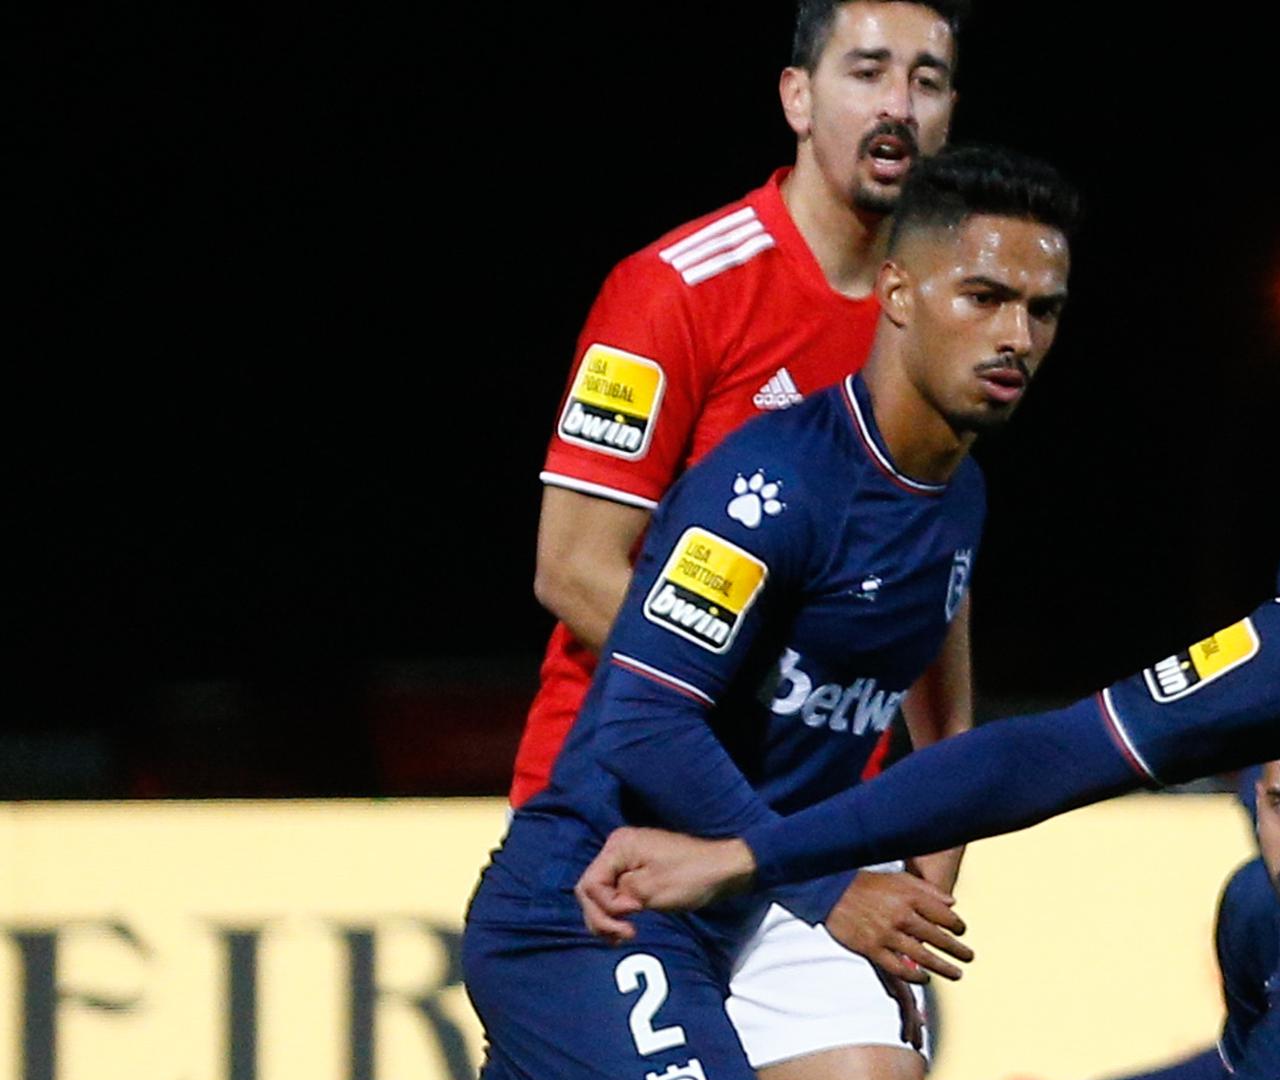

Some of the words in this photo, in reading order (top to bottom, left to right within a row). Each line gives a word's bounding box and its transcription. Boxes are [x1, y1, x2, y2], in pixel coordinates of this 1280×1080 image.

[587, 359, 607, 376] LIGA
[582, 374, 634, 404] PORTUGAL
[562, 402, 643, 451] bwin
[685, 542, 711, 563] LIGA
[677, 557, 734, 598] PORTUGAL
[649, 583, 731, 644] bwin
[615, 953, 687, 1057] 2
